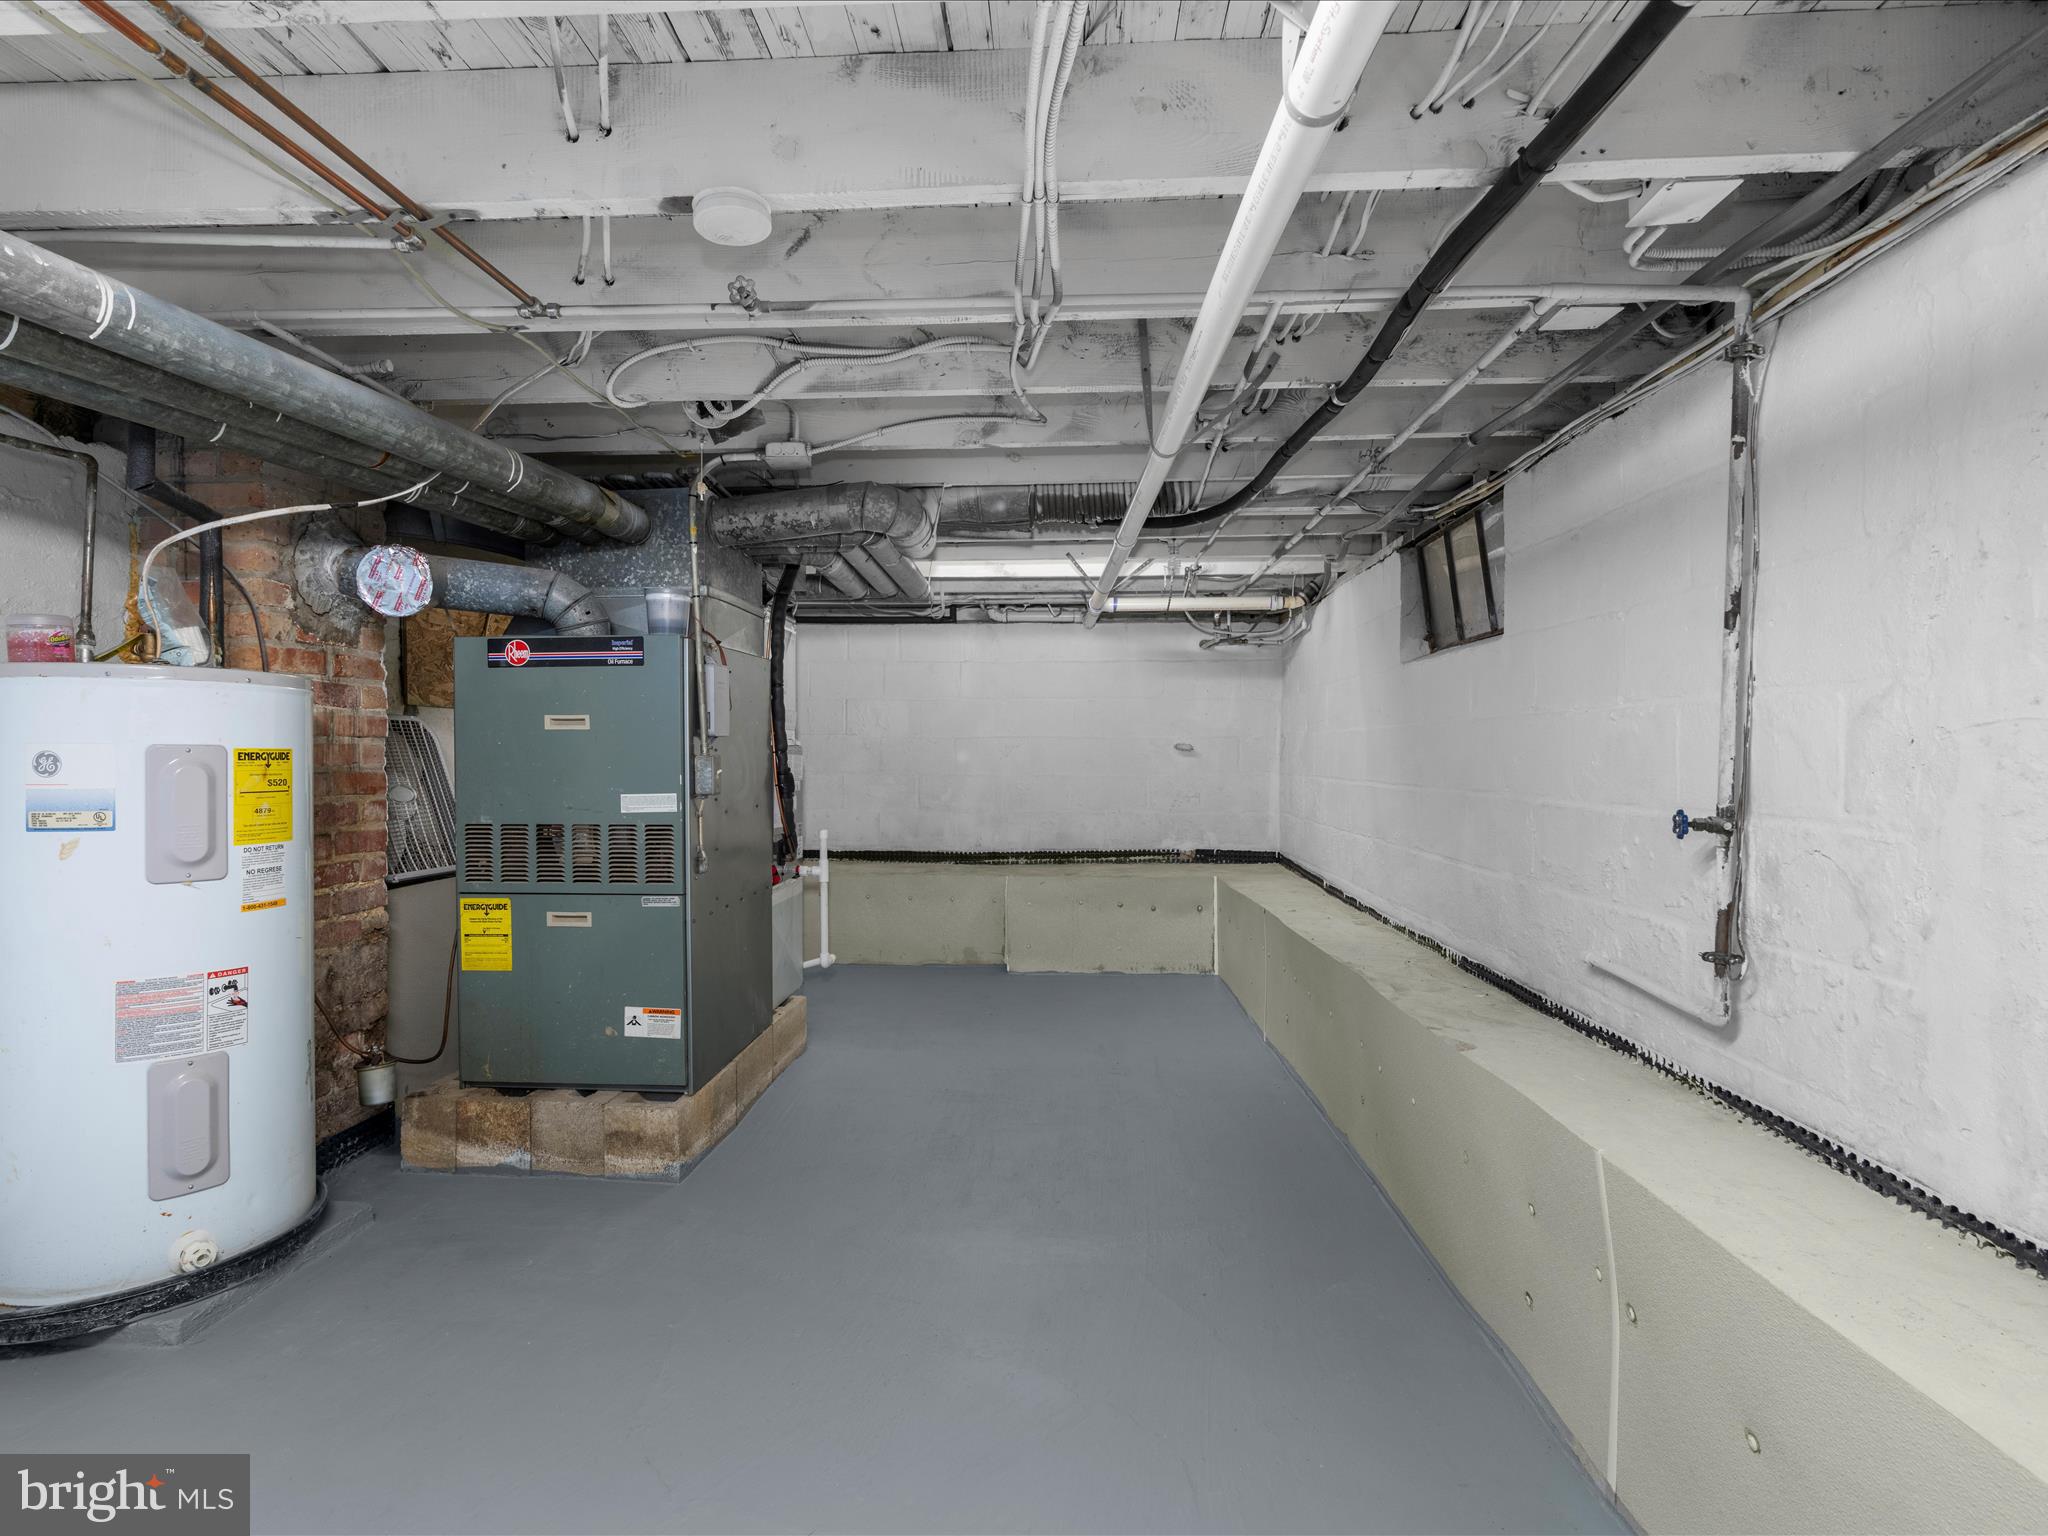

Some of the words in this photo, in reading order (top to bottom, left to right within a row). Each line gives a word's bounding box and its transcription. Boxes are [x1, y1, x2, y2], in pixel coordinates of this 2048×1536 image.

[508, 640, 529, 662] Rheem
[237, 751, 291, 761] ENERGYGUIDE
[463, 903, 508, 911] ENERGYGUIDE
[217, 968, 247, 977] DANGER
